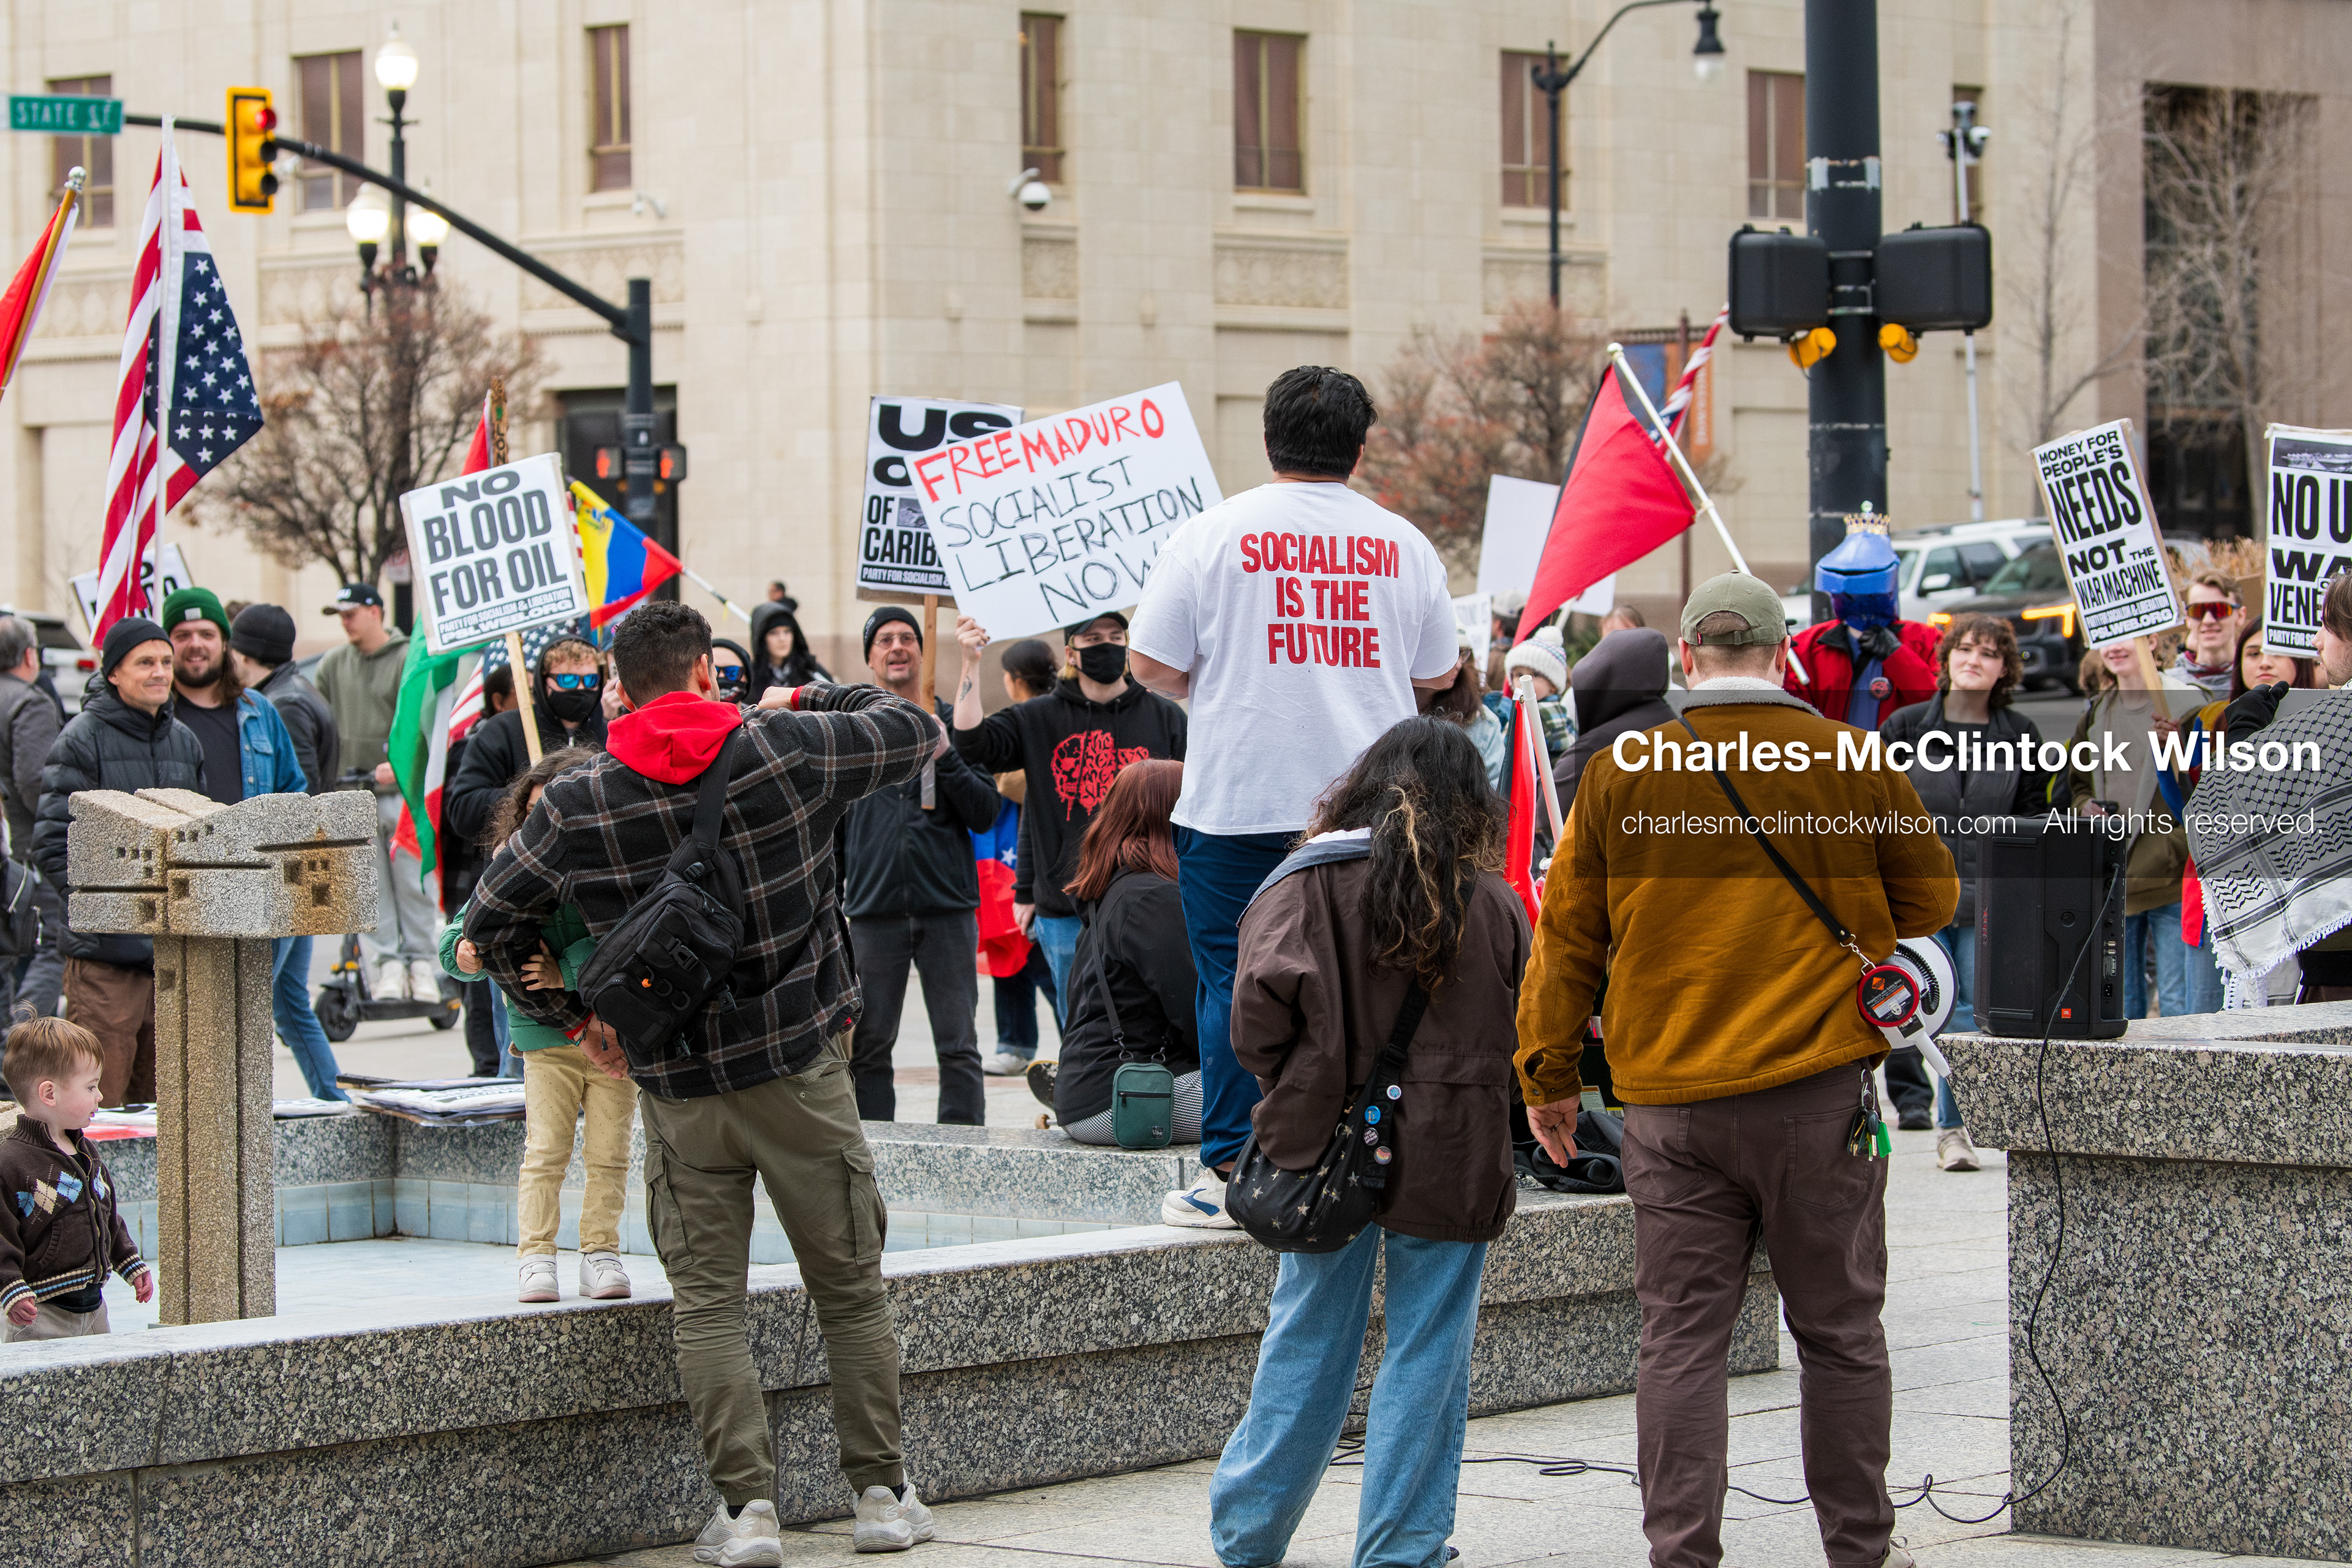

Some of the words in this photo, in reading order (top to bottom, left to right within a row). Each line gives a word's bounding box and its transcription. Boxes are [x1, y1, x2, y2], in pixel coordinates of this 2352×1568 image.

[17, 102, 75, 126] STATE
[2039, 439, 2084, 466] MONEY
[2087, 430, 2119, 450] FOR
[2042, 443, 2124, 481] PEOPLE'S
[440, 469, 521, 510] NO
[867, 494, 895, 525] OF
[940, 454, 1134, 548] SOCIALIST
[2048, 461, 2143, 545] NEEDS
[2272, 471, 2320, 540] NO
[423, 489, 552, 565] BLOOD
[863, 526, 943, 568] CARIB
[956, 475, 1204, 592] LIBERATION
[862, 567, 888, 581] PARTY
[887, 569, 902, 582] FOR
[902, 570, 944, 584] SOCIALISM
[1240, 531, 1400, 579] SOCIALISM
[2067, 537, 2127, 578] NOT
[2129, 546, 2155, 560] THE
[430, 557, 505, 617] FOR
[506, 541, 568, 594] OIL
[1276, 576, 1305, 618] IS
[1311, 580, 1370, 621] THE
[2075, 576, 2106, 611] WAR
[2101, 558, 2165, 603] MACHINE
[439, 617, 462, 634] PARTY
[462, 614, 478, 628] FOR
[477, 601, 517, 624] SOCIALISM
[517, 599, 528, 613] &
[527, 587, 571, 609] LIBERATION
[441, 600, 572, 643] PSLWEB.ORG
[2090, 609, 2172, 640] PSLWEB.ORG
[1268, 624, 1381, 669] FUTURE
[2268, 628, 2291, 644] PARTY
[2290, 630, 2305, 646] FOR
